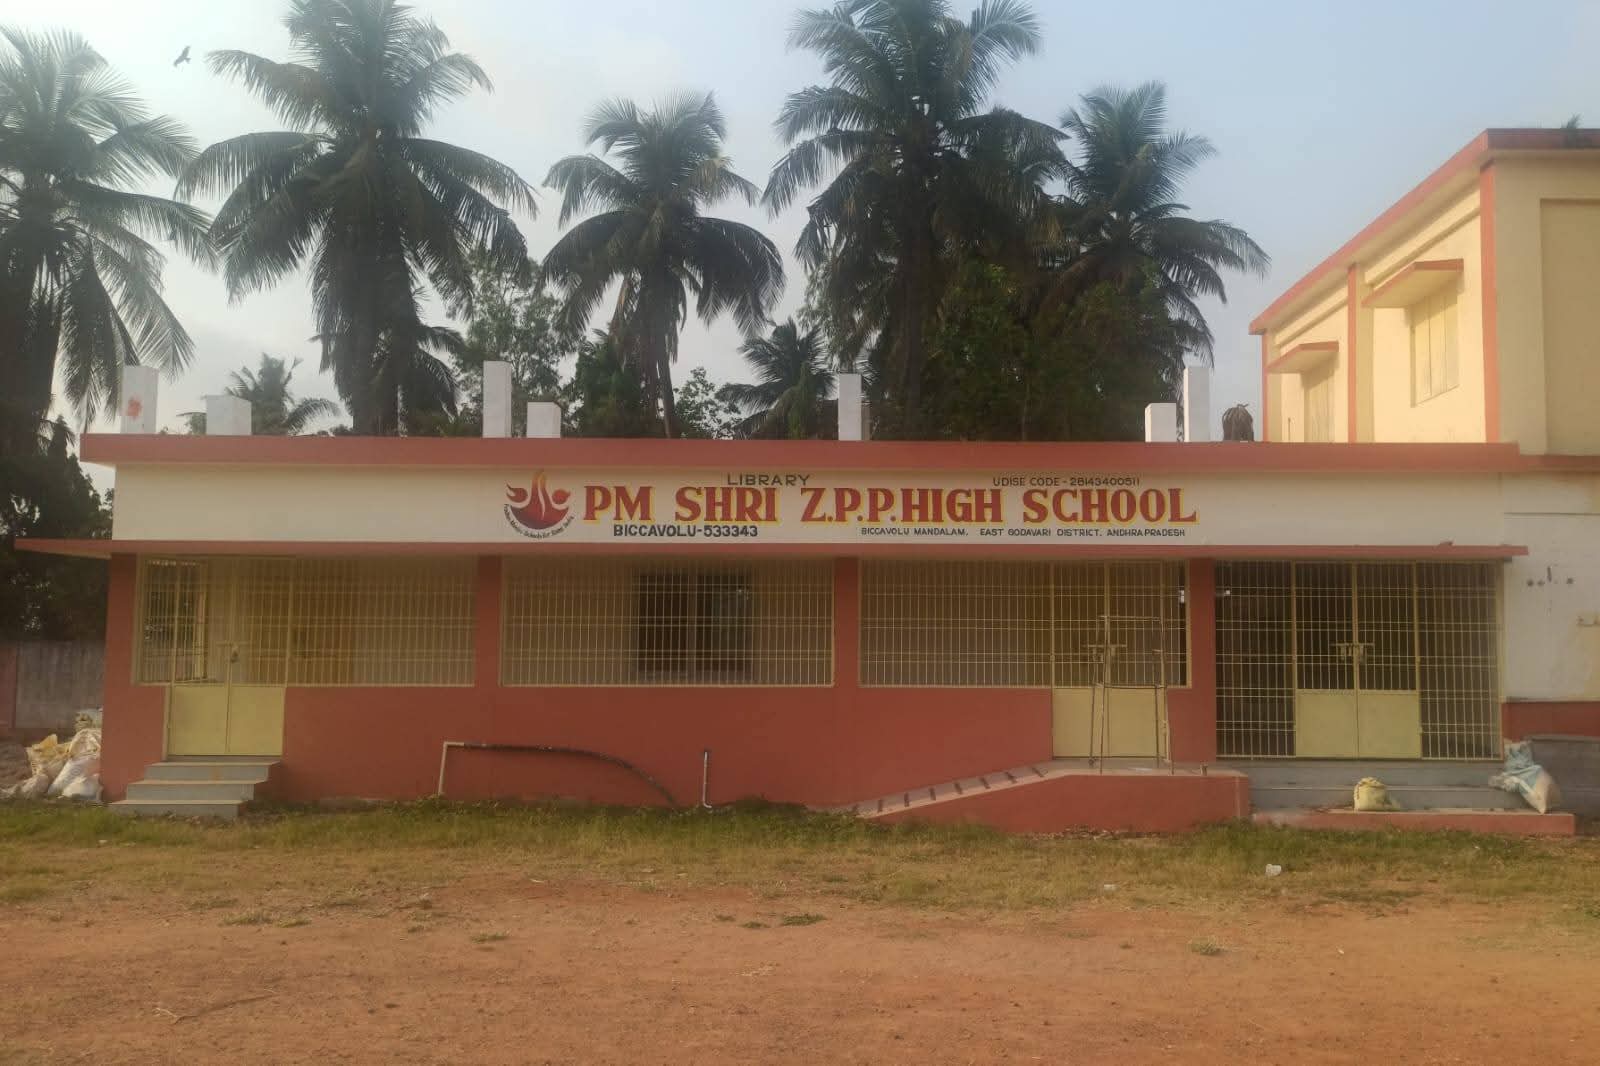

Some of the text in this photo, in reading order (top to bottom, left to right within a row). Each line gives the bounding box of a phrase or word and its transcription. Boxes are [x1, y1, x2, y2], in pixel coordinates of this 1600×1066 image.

[727, 474, 811, 486] LIBRARY
[992, 477, 1026, 487] UDISE
[1029, 477, 1060, 487] CODE
[583, 485, 654, 521] PM
[675, 486, 778, 522] SHRI
[1022, 488, 1198, 524] SCHOOL
[613, 524, 758, 538] BICCAVOLU-533343
[861, 527, 910, 536] BICCAVOLU
[980, 528, 1004, 537] EAST
[1008, 529, 1051, 537] GODAVARI
[1106, 529, 1144, 537] ANDHRA
[1144, 529, 1185, 537] PRADESH
